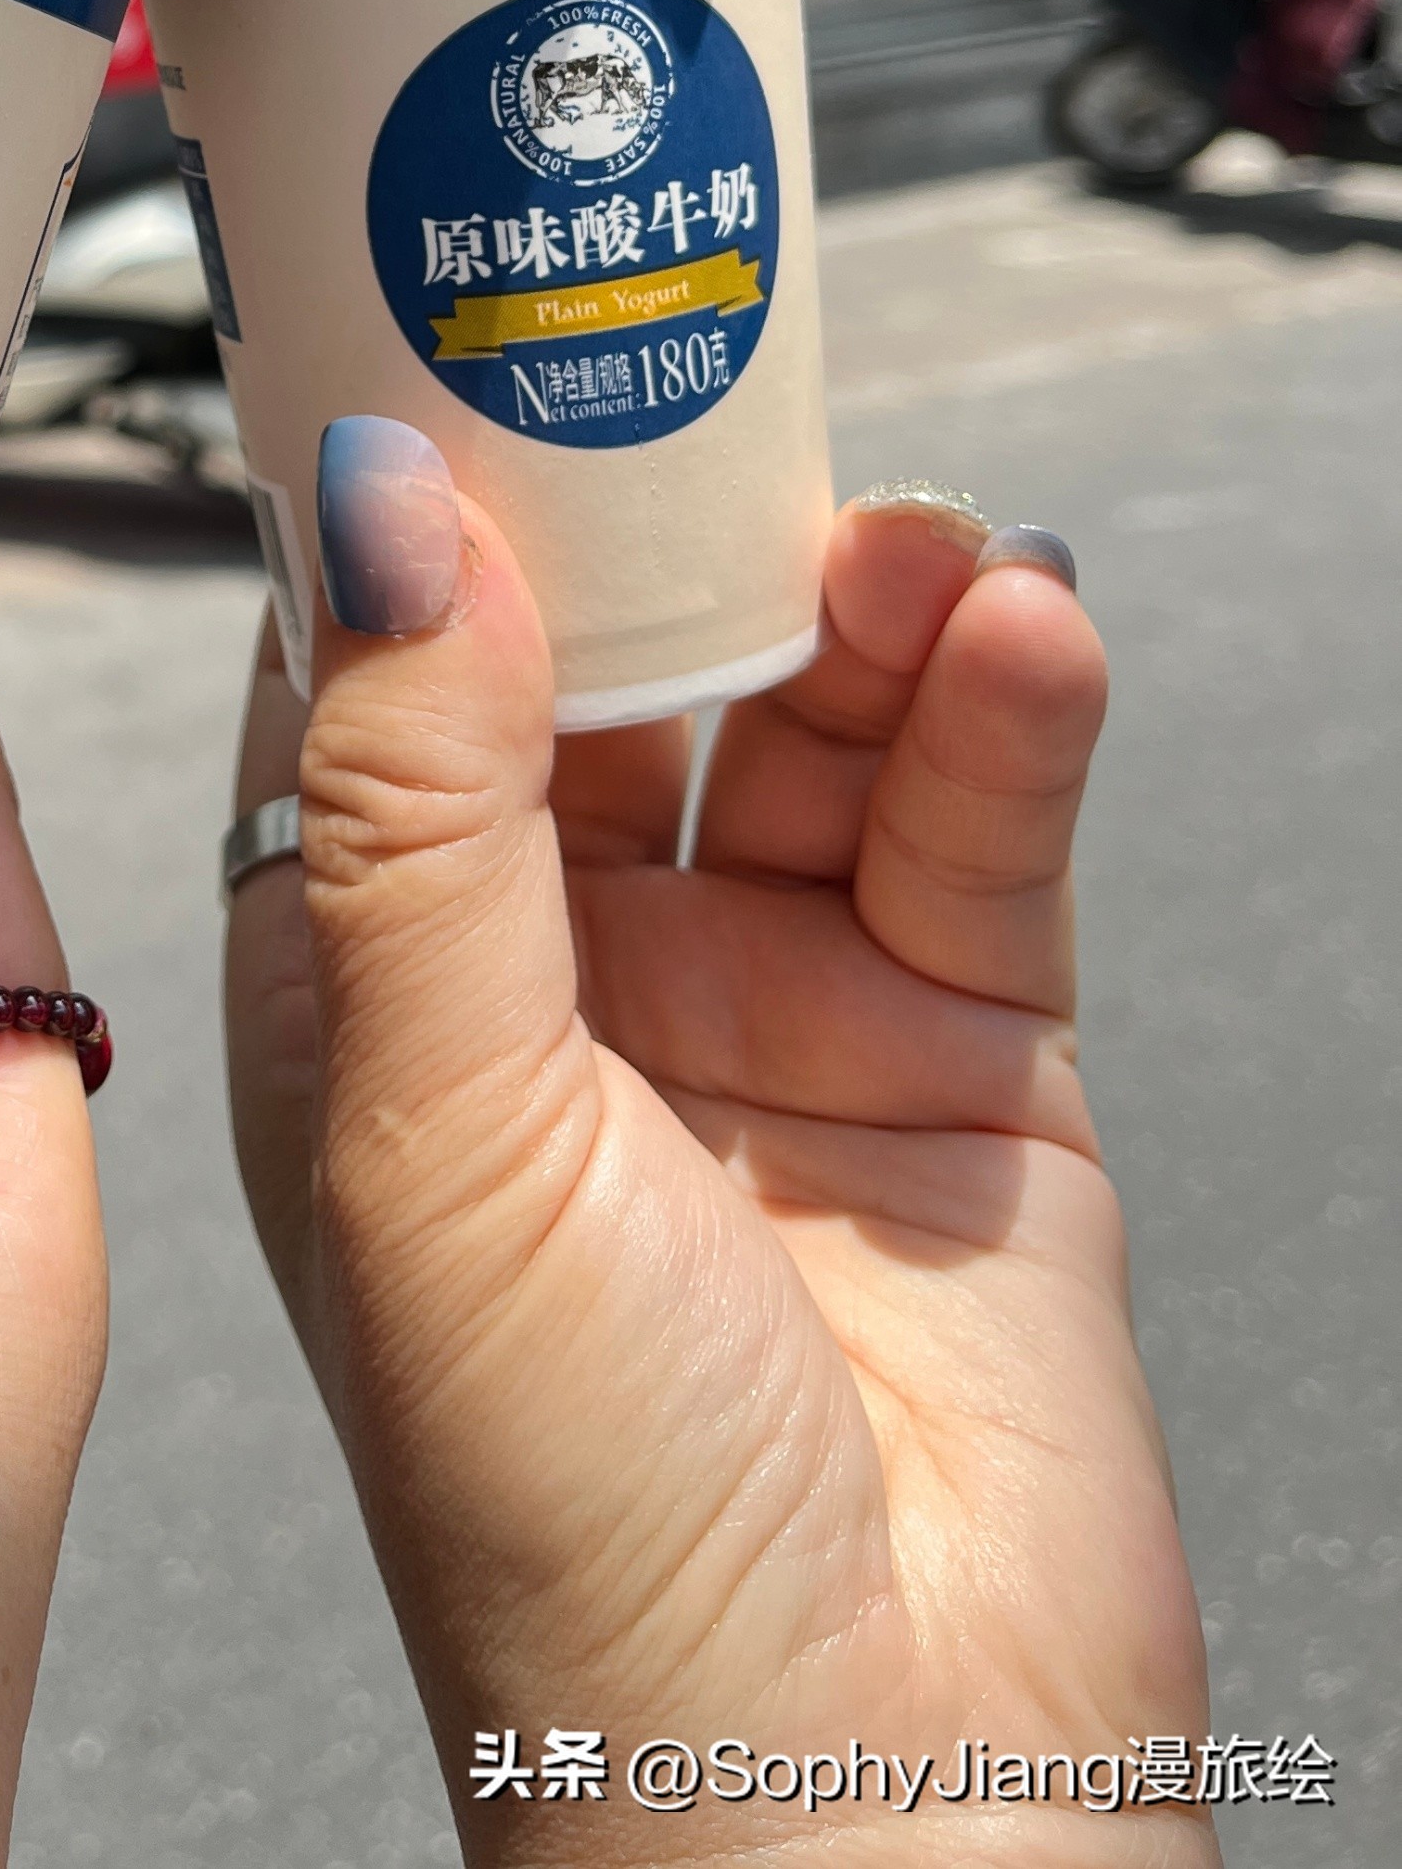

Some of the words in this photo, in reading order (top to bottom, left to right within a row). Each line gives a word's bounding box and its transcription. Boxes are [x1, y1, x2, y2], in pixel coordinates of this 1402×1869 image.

[421, 162, 761, 288] 原味酸牛奶
[535, 294, 601, 327] Plain
[612, 278, 692, 319] Yogurt
[638, 326, 731, 408] 180克
